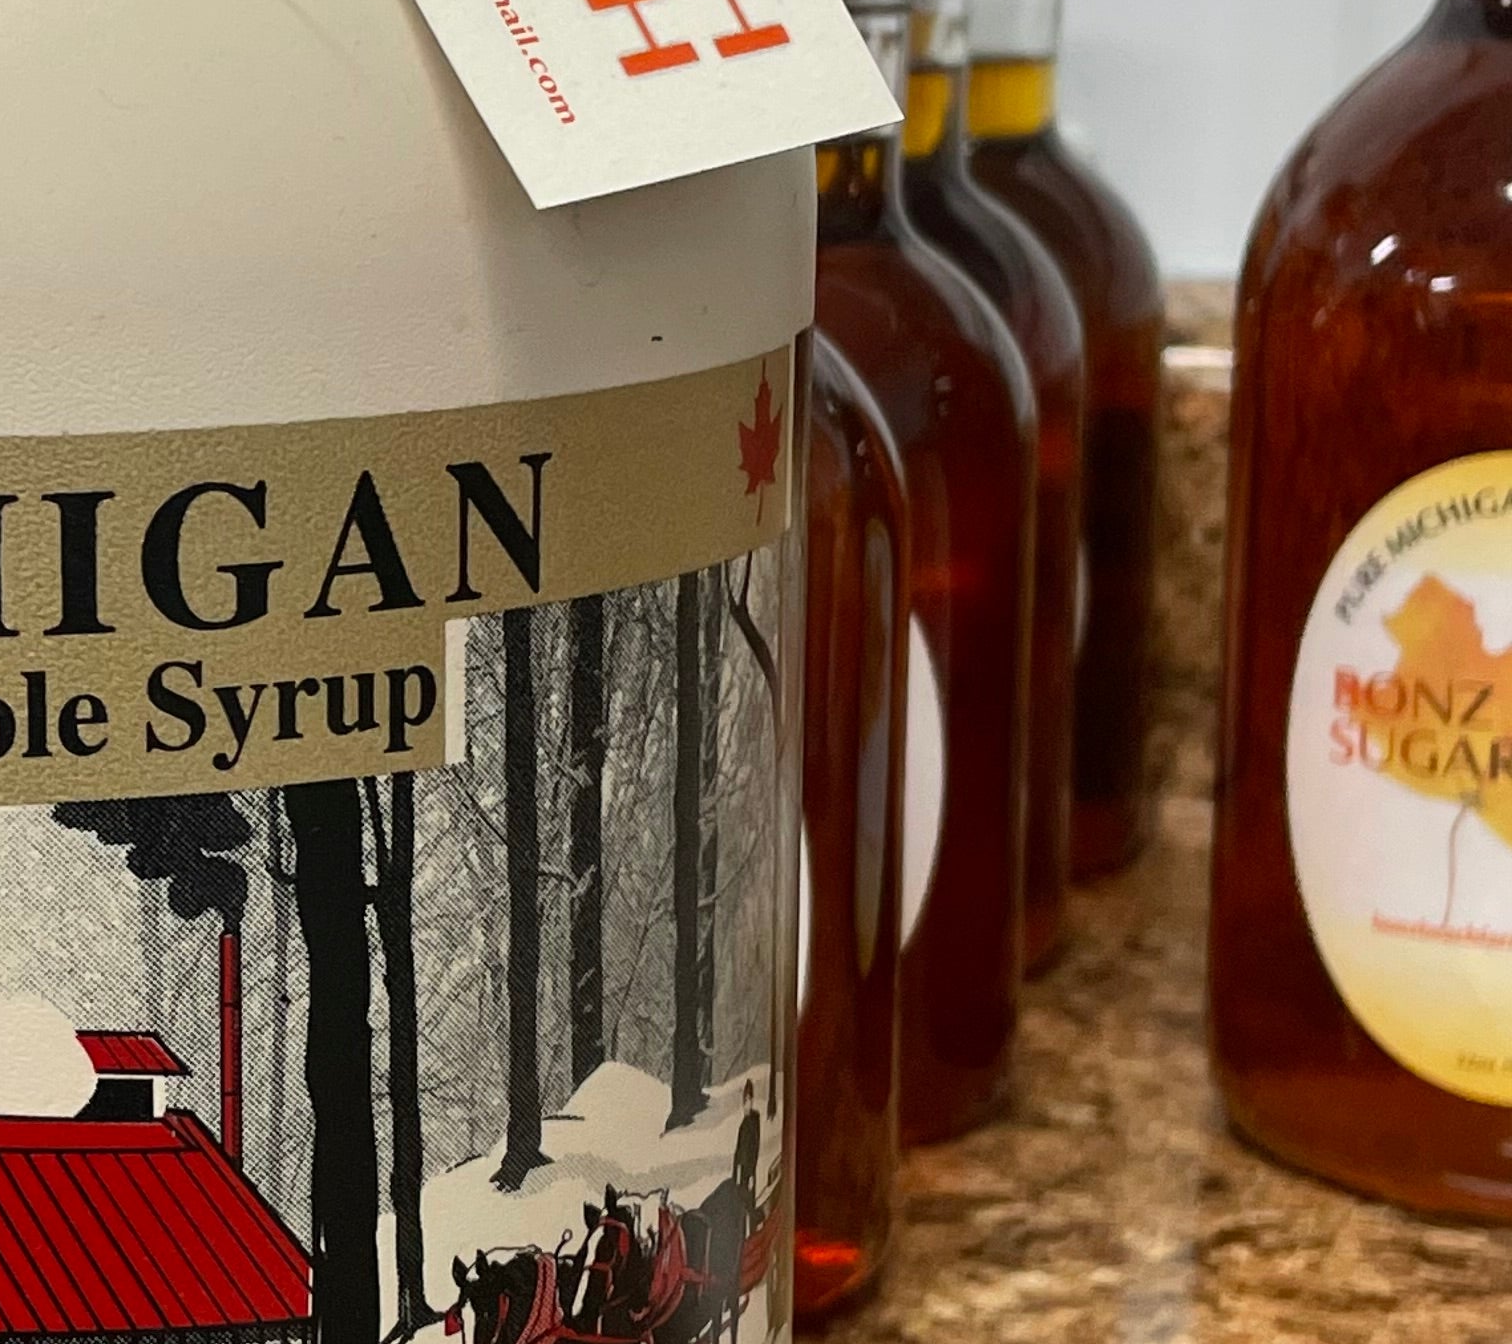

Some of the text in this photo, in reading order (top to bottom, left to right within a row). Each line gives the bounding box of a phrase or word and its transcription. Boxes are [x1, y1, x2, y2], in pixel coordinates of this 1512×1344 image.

[142, 658, 439, 772] Syrup
[1334, 664, 1494, 732] BONZ
[1329, 717, 1512, 782] SUGAR
